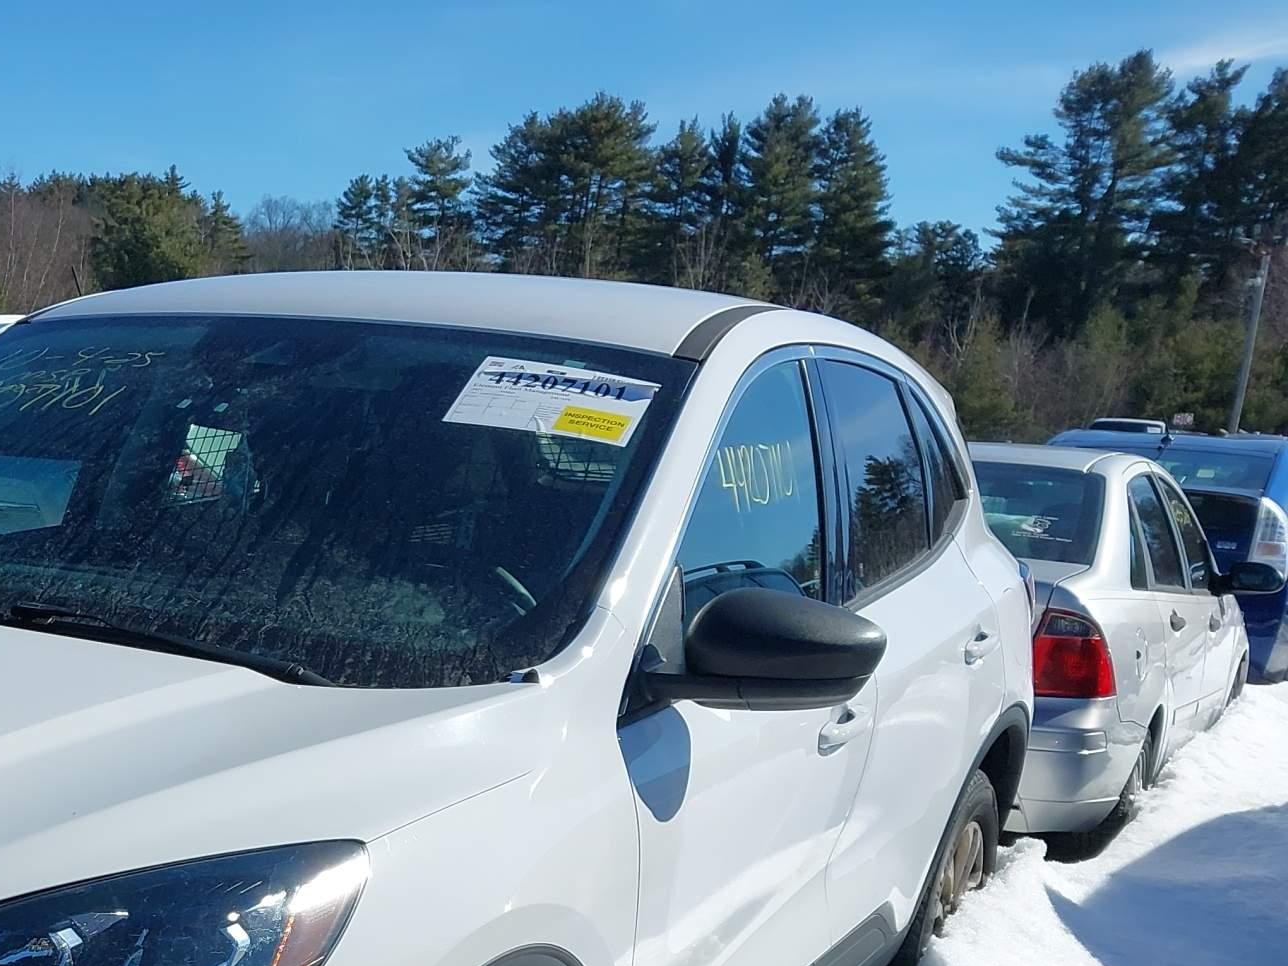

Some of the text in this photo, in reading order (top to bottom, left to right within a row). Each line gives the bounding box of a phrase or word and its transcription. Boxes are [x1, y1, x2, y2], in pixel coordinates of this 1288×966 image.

[487, 371, 628, 401] 44207101
[563, 411, 626, 429] INSPECTION
[567, 418, 615, 433] SERVICE
